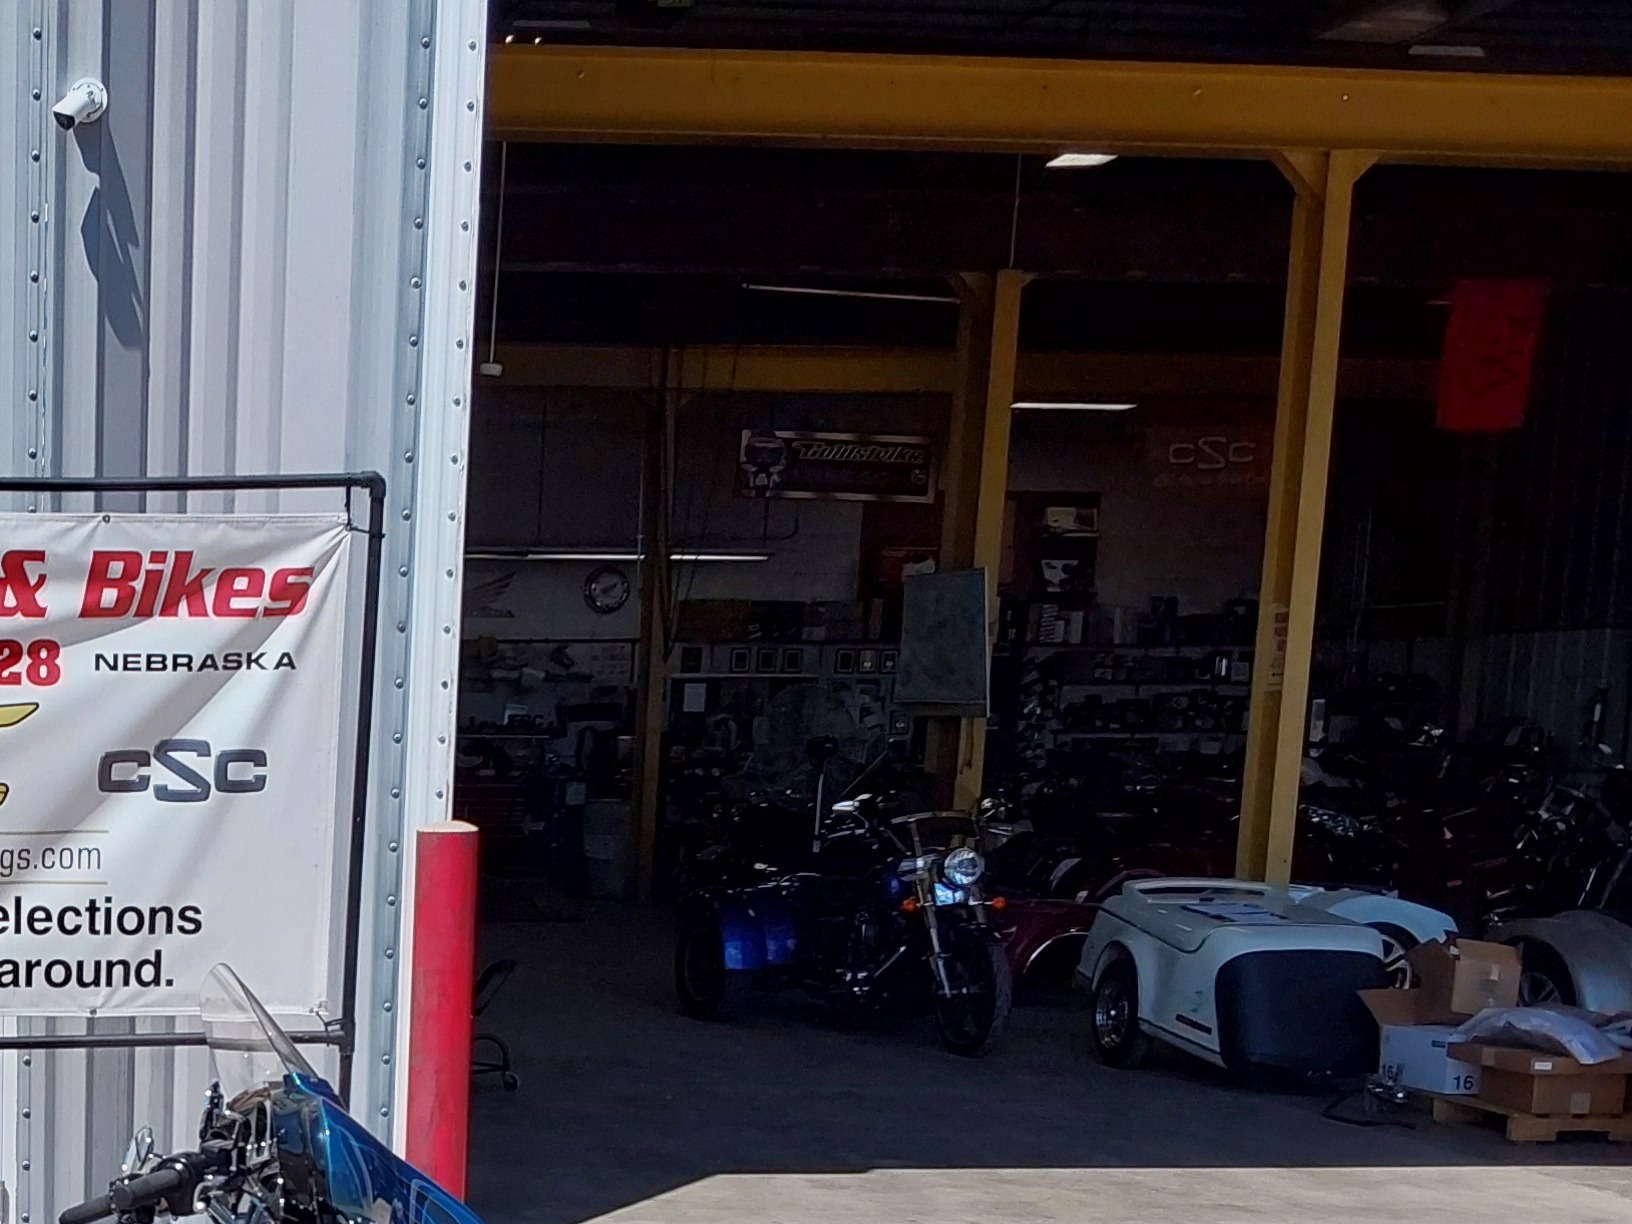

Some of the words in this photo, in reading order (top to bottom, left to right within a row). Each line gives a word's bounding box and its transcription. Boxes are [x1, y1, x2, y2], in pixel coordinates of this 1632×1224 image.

[80, 551, 314, 618] Bikes
[95, 651, 297, 672] NEBRASKA
[1453, 1074, 1475, 1092] 16
